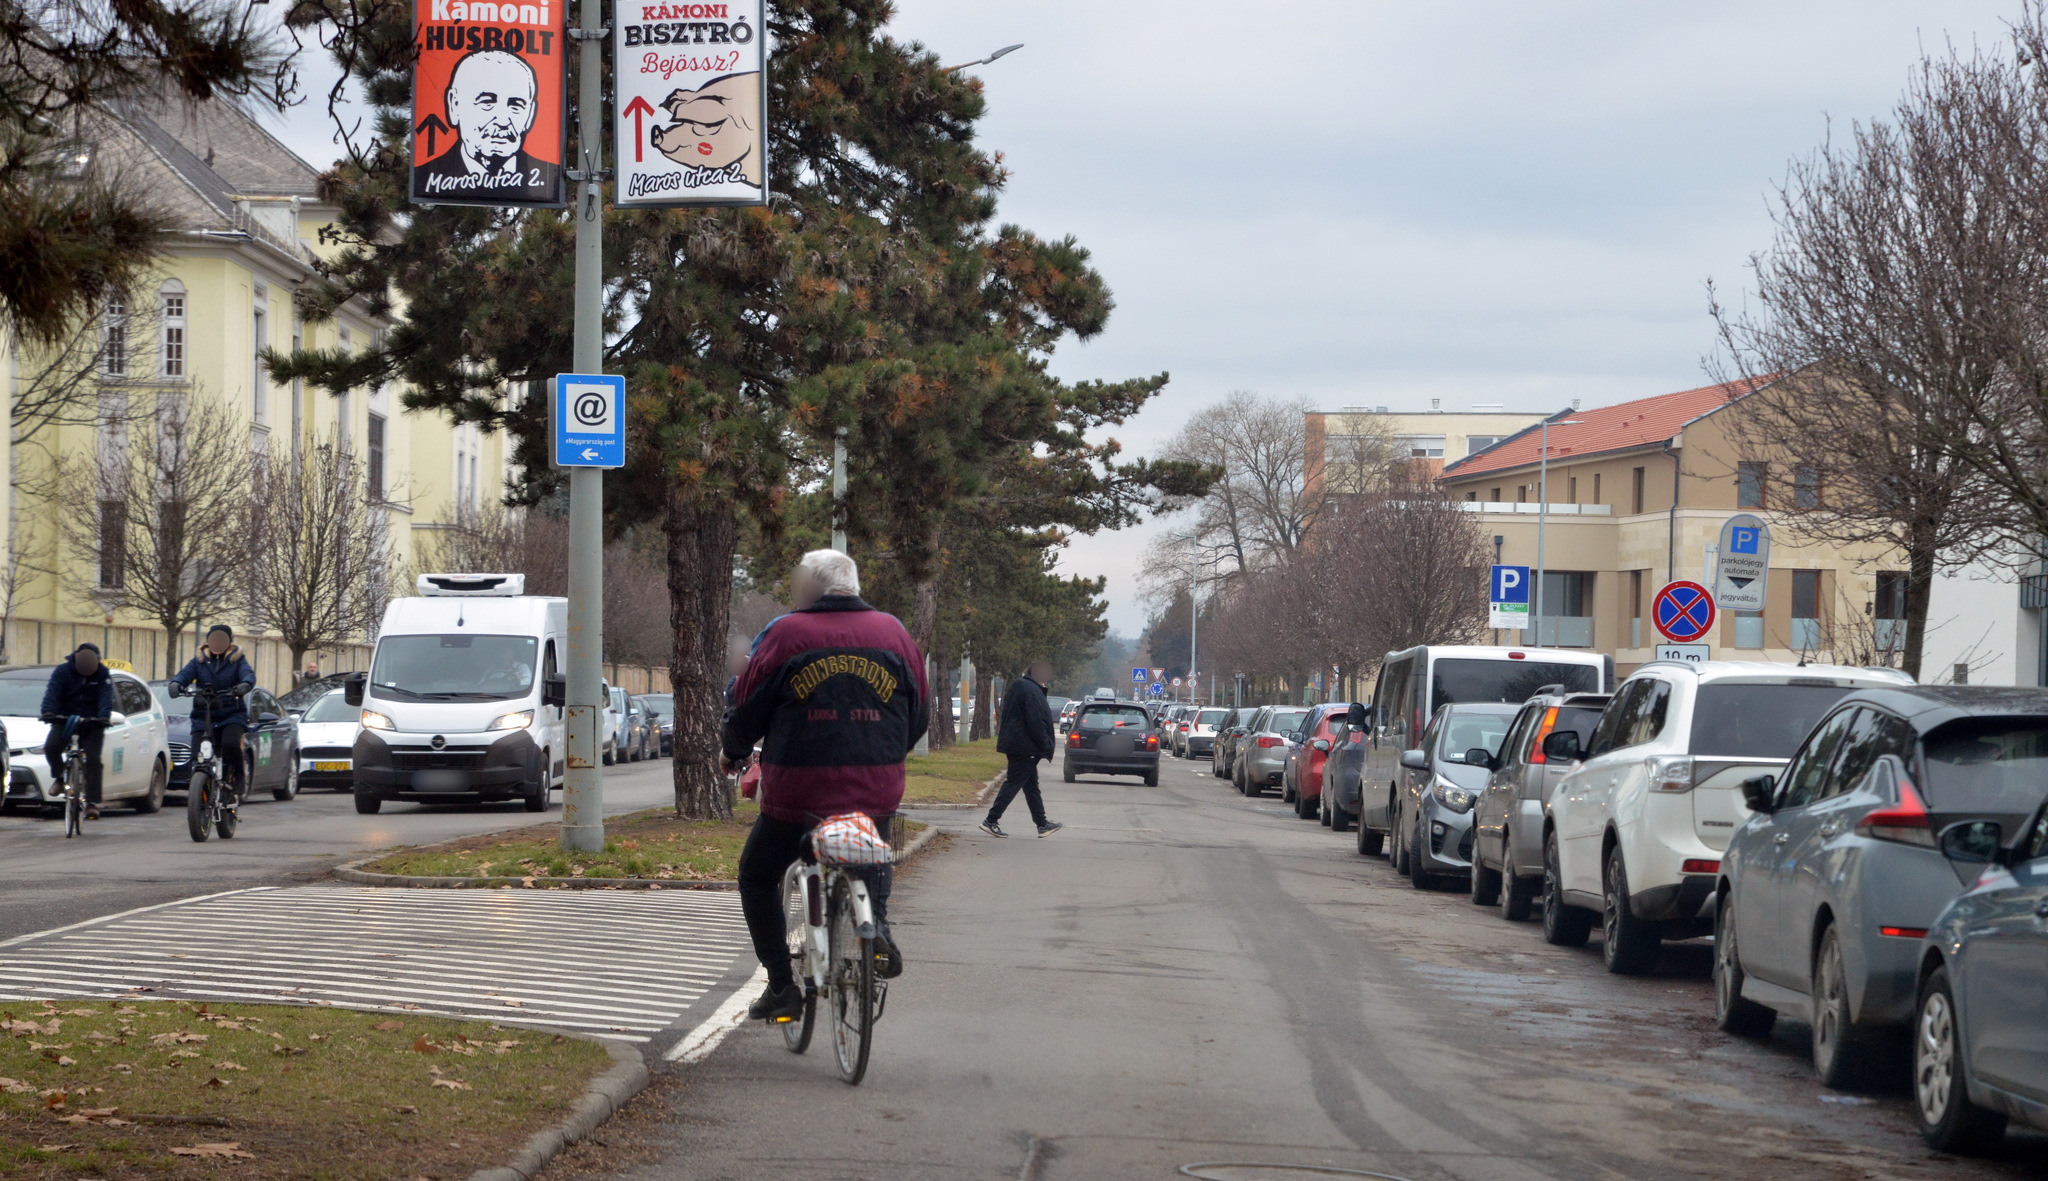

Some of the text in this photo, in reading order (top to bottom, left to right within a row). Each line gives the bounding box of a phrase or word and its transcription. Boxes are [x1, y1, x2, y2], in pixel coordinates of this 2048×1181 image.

[642, 1, 728, 21] KÁMONI
[426, 18, 555, 56] HÚSBOLT
[624, 15, 754, 48] BISZTRÓ
[640, 50, 740, 81] Bejössz?
[425, 167, 545, 194] Maros utca 2.
[628, 161, 748, 197] Maros utca 2.
[565, 437, 603, 446] eMagyarország
[1737, 531, 1753, 550] P
[1721, 557, 1764, 568] parkolójegy
[1724, 567, 1760, 577] automata
[1500, 569, 1520, 600] P
[1720, 592, 1758, 603] jegyváltás
[107, 661, 126, 670] TAXI
[1686, 654, 1701, 662] m
[850, 709, 881, 721] STYLE
